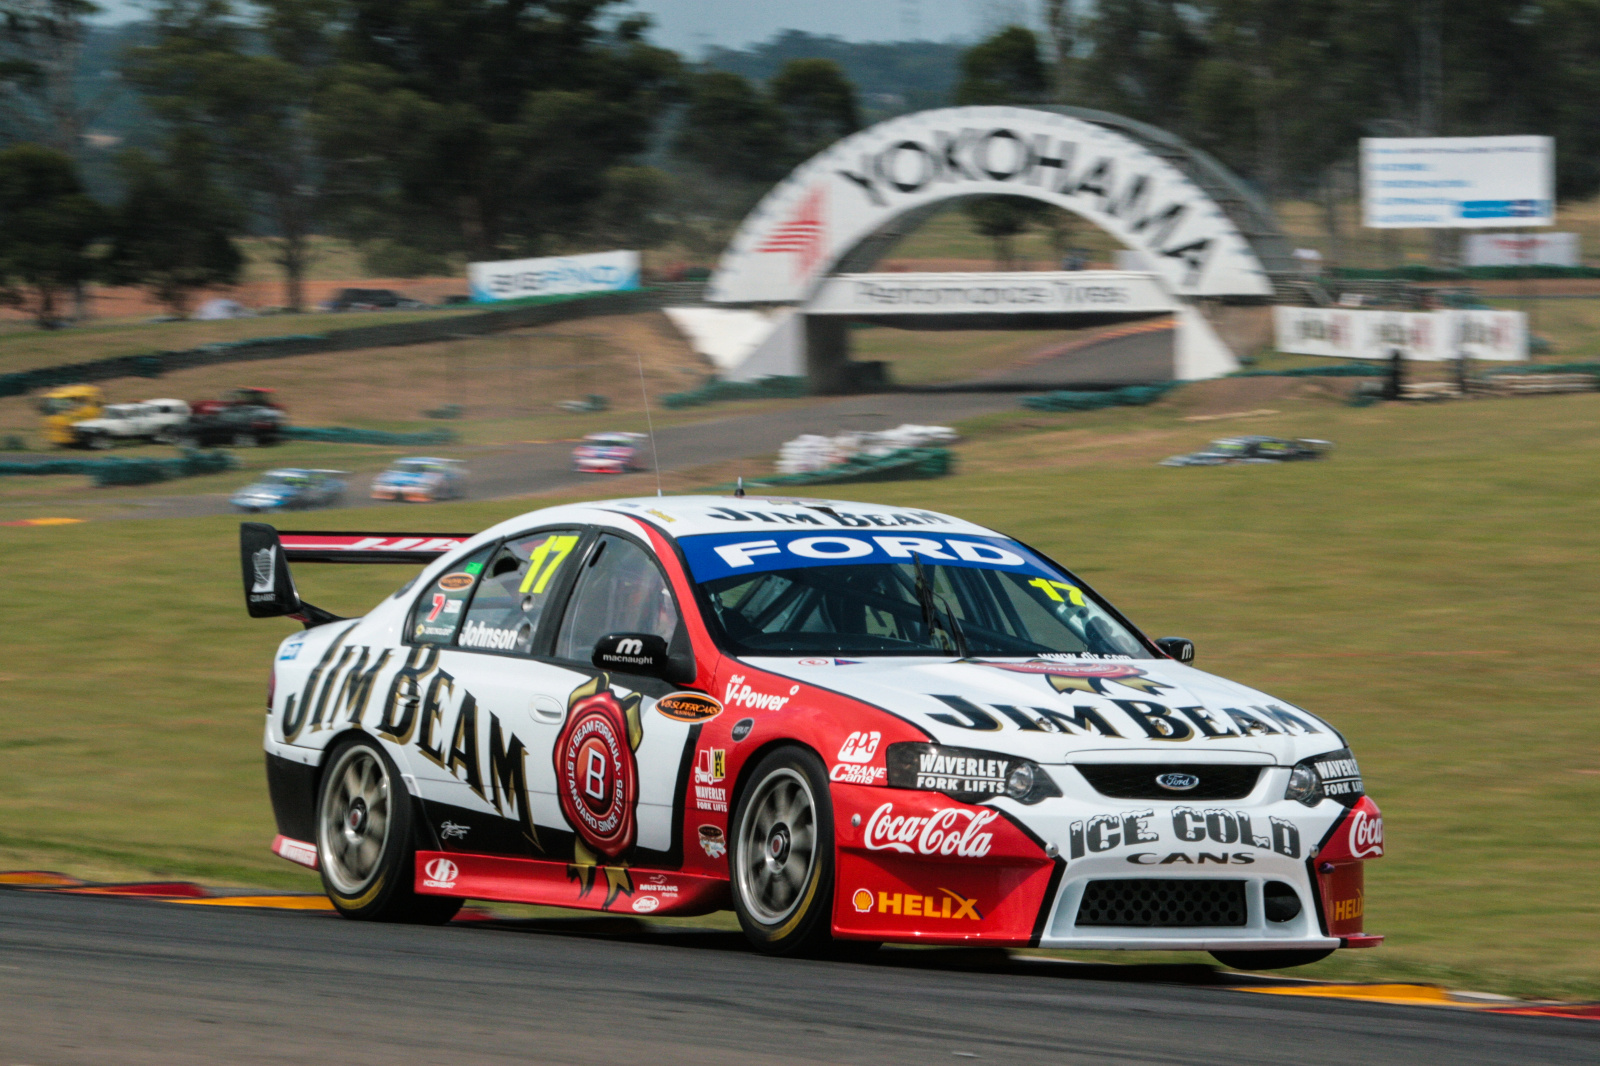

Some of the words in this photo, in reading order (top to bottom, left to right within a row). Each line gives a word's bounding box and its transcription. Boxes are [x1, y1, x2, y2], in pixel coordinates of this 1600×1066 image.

[837, 127, 1214, 287] YOKOHAMA
[706, 506, 827, 526] JIM
[822, 512, 951, 527] BEAM
[518, 534, 580, 594] 17
[713, 535, 1026, 568] FORD
[1028, 577, 1086, 607] 17
[458, 619, 518, 650] Johnson
[603, 654, 653, 665] macnaught
[730, 674, 746, 685] Shell
[724, 682, 790, 711] V-Power
[923, 694, 1129, 740] JIM
[1102, 698, 1324, 742] BEAM
[283, 624, 395, 744] JIM
[376, 643, 545, 853] BEAM
[573, 720, 595, 748] BEAM
[594, 720, 622, 771] FORMULA
[585, 746, 607, 801] B
[919, 754, 1009, 778] WAVERLEY
[1314, 759, 1360, 779] WAVERLE
[567, 761, 598, 829] STANDARD
[598, 811, 619, 832] SINCE
[695, 785, 726, 801] WAVERLEY
[917, 776, 958, 790] FORK
[964, 780, 1005, 793] LIFTS
[1324, 783, 1352, 796] FORK
[697, 801, 712, 810] FORK
[713, 803, 728, 812] LIFTS
[864, 802, 999, 858] Coca-Cola
[1069, 807, 1160, 860] ICE
[1171, 805, 1300, 859] COLD
[1126, 852, 1256, 865] CANS
[639, 884, 679, 892] MUSTANG
[877, 887, 985, 921] HELIX
